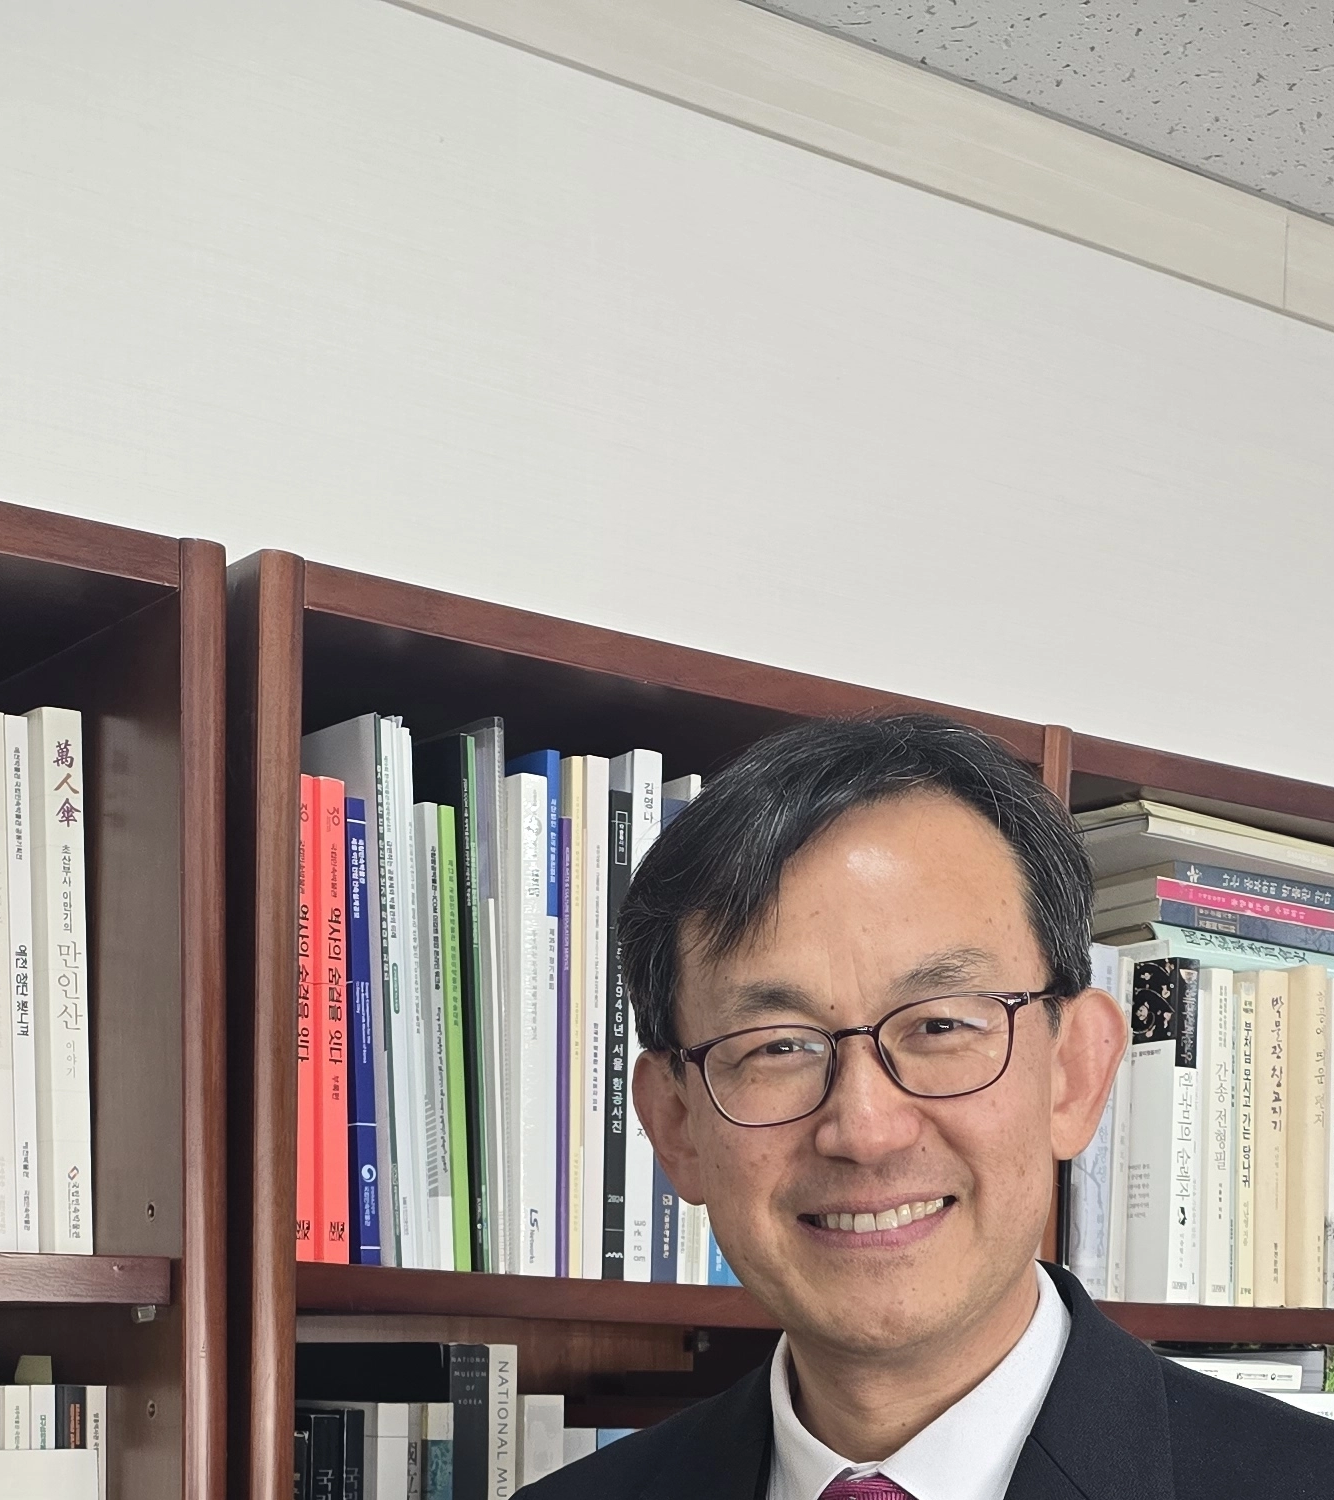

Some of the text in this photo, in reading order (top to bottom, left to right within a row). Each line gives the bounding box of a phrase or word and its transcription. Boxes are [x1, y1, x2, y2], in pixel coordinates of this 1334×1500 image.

[53, 738, 81, 828] 萬人傘
[327, 907, 342, 961] 역사의
[56, 939, 83, 1031] 만인산
[328, 1029, 344, 1066] 잇다
[496, 1360, 510, 1461] NATIONAL
